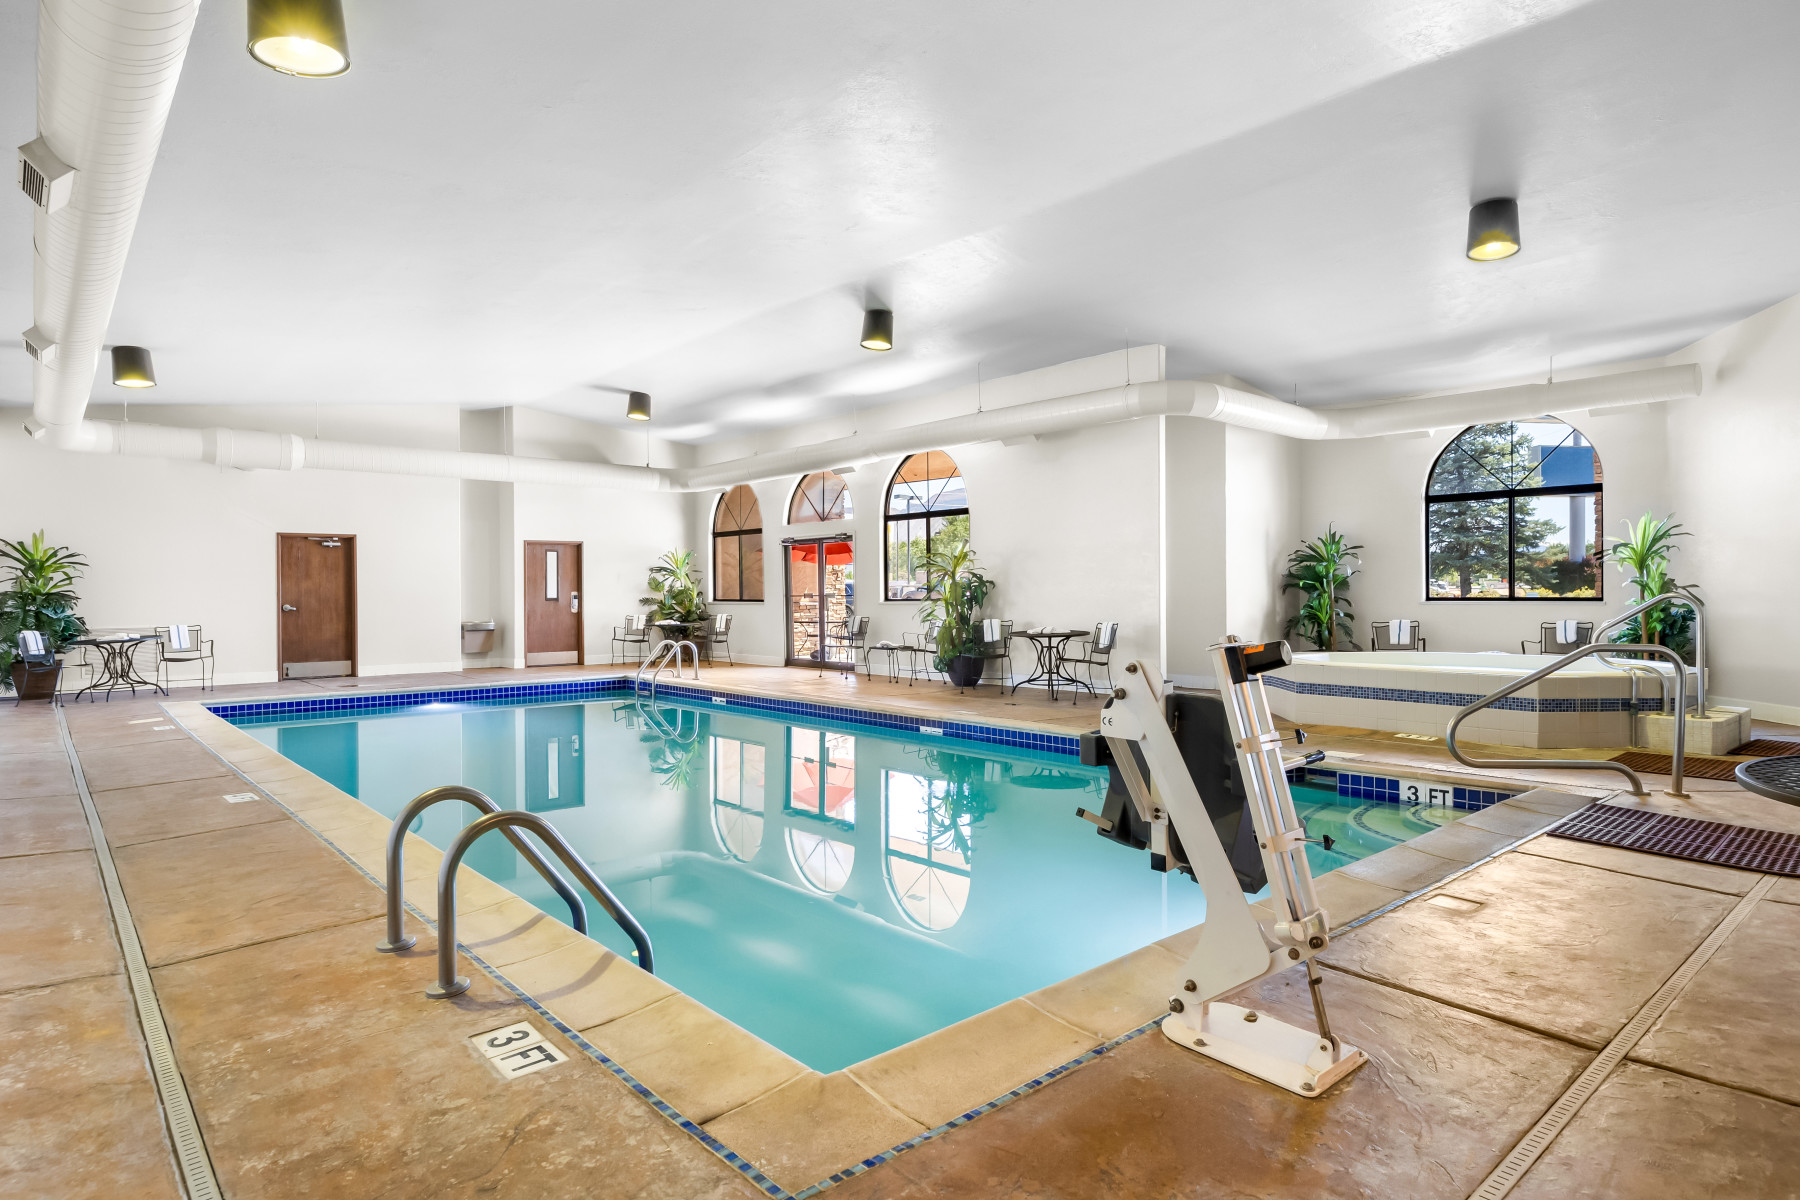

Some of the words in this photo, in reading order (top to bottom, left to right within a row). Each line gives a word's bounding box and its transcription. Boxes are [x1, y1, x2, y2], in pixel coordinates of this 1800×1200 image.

[1102, 716, 1112, 727] CE
[1407, 785, 1419, 801] 3
[1429, 788, 1450, 805] FT
[487, 1030, 530, 1049] 3
[500, 1045, 558, 1072] FT
